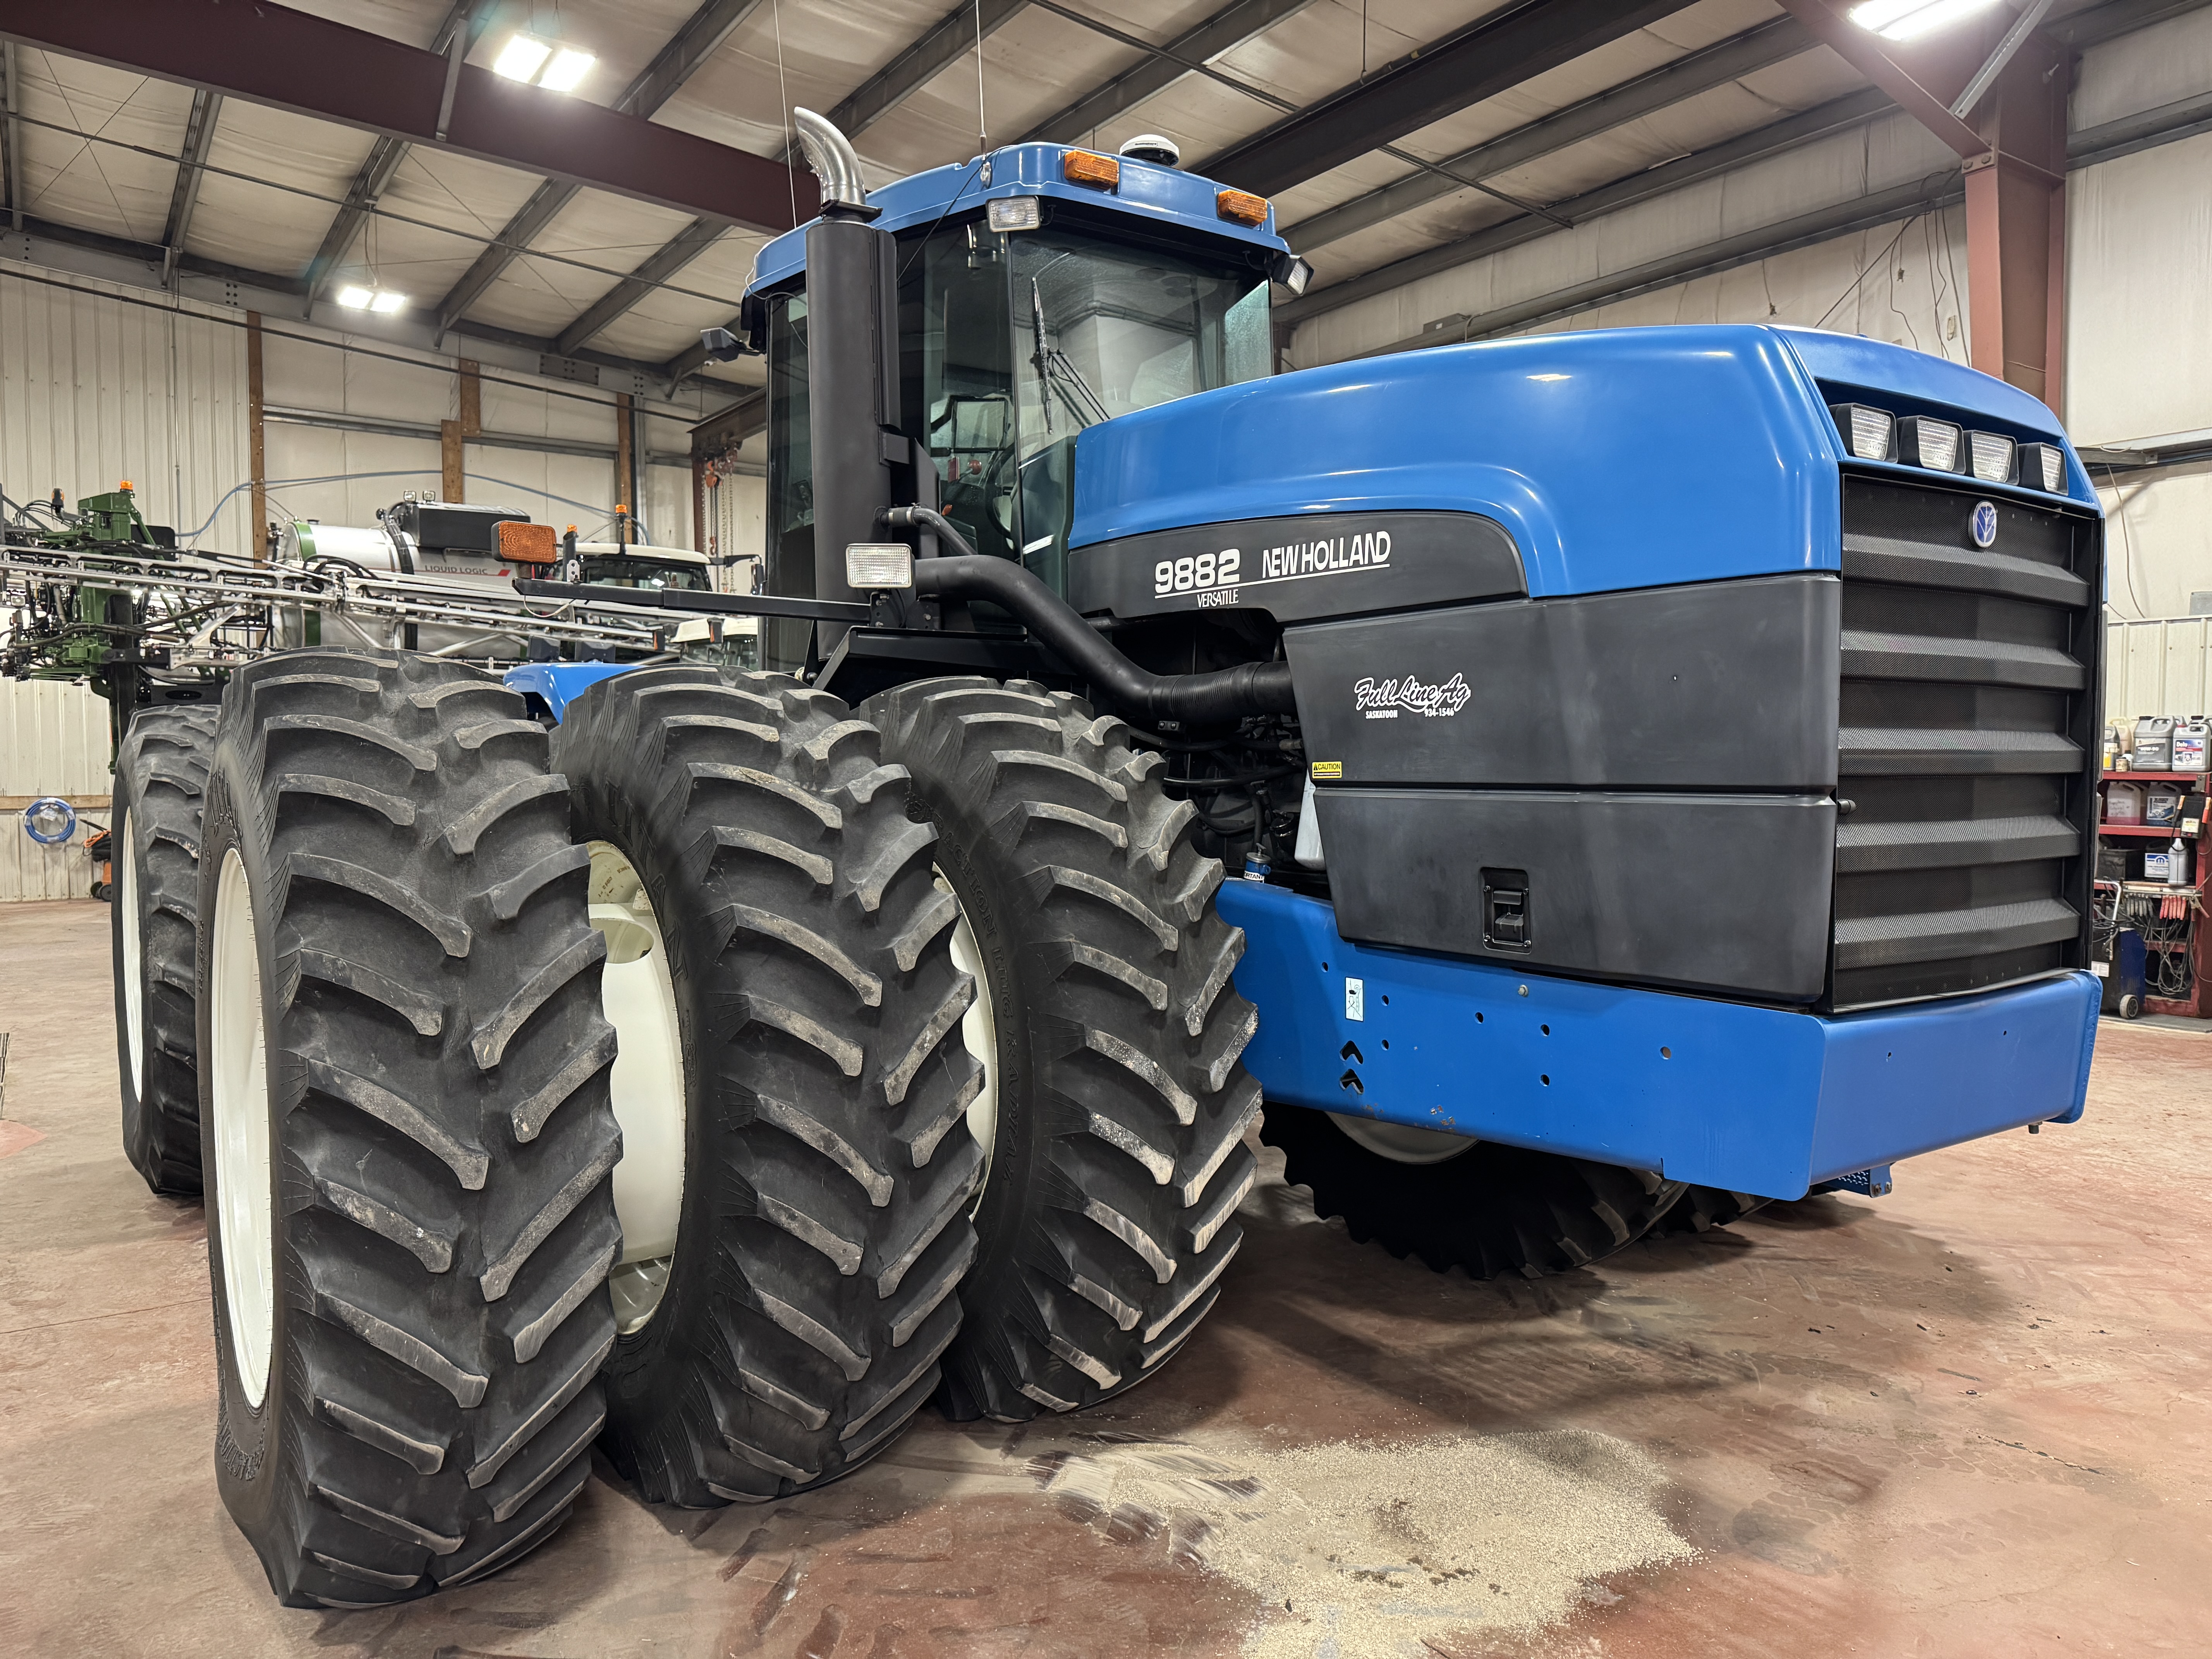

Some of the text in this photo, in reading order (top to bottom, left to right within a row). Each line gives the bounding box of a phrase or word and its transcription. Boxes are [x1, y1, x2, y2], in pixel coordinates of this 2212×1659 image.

[1154, 531, 1391, 594] 9882 NEW HOLLAND
[1197, 589, 1239, 608] VERSATILE
[1354, 672, 1471, 713] Full Line Ag
[1365, 709, 1398, 719] SASKATOON
[1424, 708, 1455, 717] 934-1546
